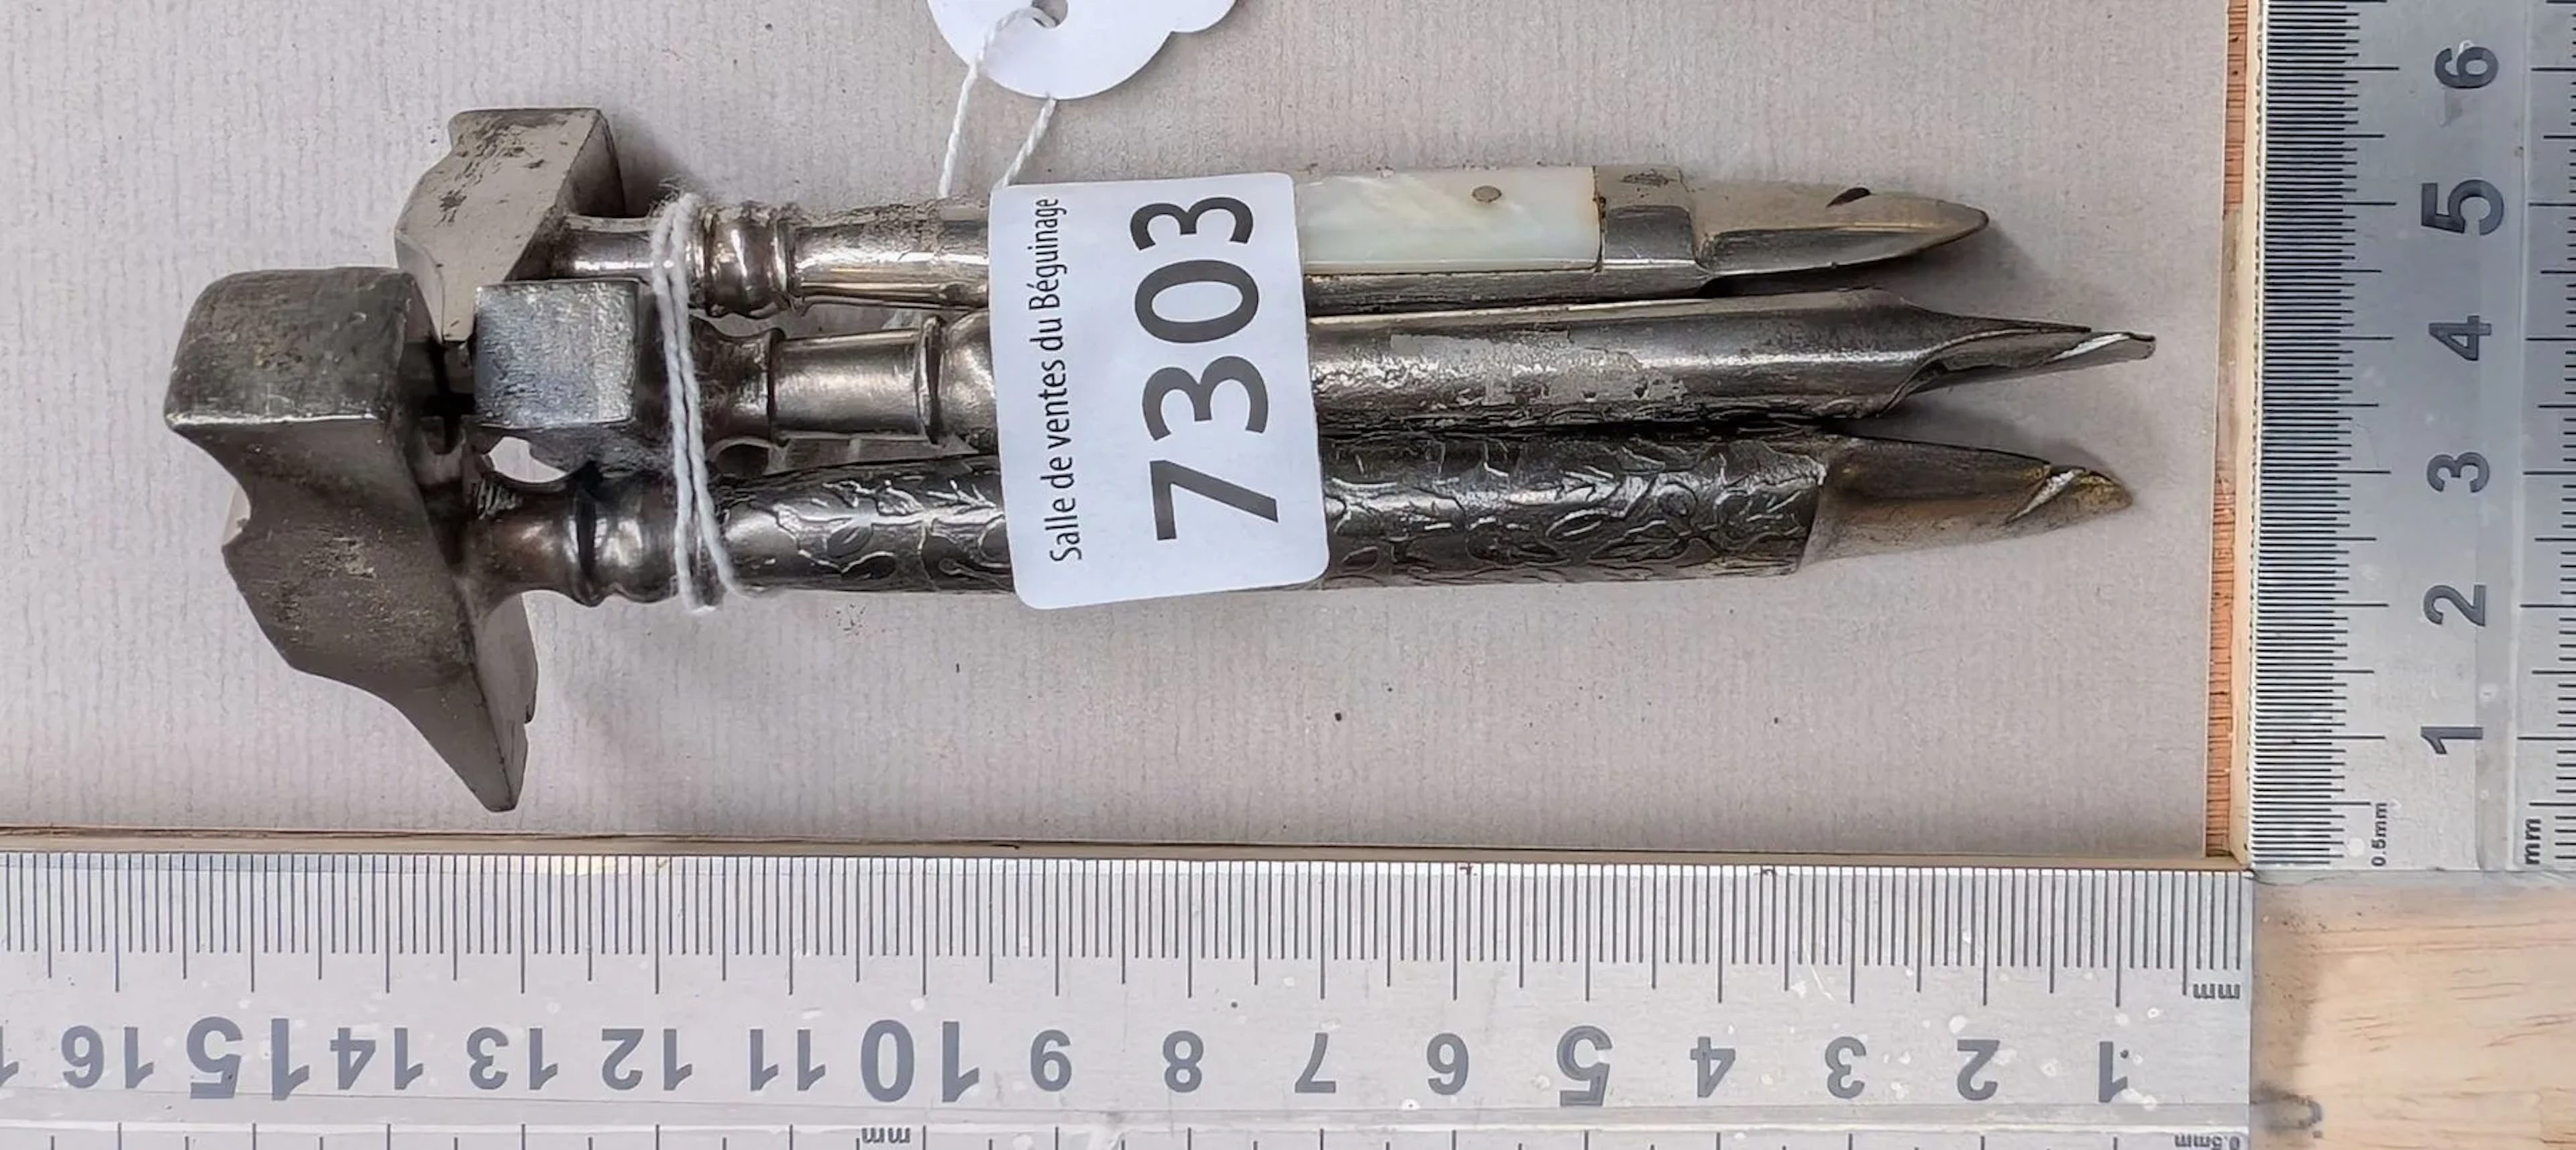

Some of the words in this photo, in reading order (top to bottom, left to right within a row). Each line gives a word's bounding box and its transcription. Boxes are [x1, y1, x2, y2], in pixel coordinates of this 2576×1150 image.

[2434, 46, 2499, 89] 6
[2422, 179, 2504, 236] 5
[1026, 198, 1068, 312] Béguinage
[1030, 318, 1063, 352] du
[2428, 315, 2491, 361] 4
[1130, 197, 1279, 541] 7303
[1038, 360, 1073, 448] ventes
[1041, 457, 1073, 491] de
[2426, 452, 2489, 493] 3
[1044, 497, 1082, 562] Salle
[2423, 584, 2485, 627] 2
[2420, 726, 2483, 755] 1
[2371, 802, 2388, 867] 0.5mm
[2525, 817, 2542, 866] mm
[2193, 984, 2241, 1000] mm
[60, 1025, 154, 1090] 16
[186, 1016, 310, 1101] 15
[329, 1027, 424, 1090] 14
[466, 1027, 559, 1090] 13
[601, 1027, 692, 1092] 12
[749, 1029, 826, 1092] 11
[860, 1019, 980, 1104] 10
[1030, 1030, 1073, 1092] 9
[1162, 1031, 1205, 1094] 8
[1295, 1033, 1336, 1094] 7
[1426, 1033, 1469, 1095] 6
[1556, 1025, 1613, 1106] 5
[1690, 1037, 1736, 1098] 4
[1825, 1037, 1867, 1100] 3
[1957, 1040, 2000, 1101] 2
[2098, 1041, 2128, 1103] 1
[861, 1127, 911, 1144] mm
